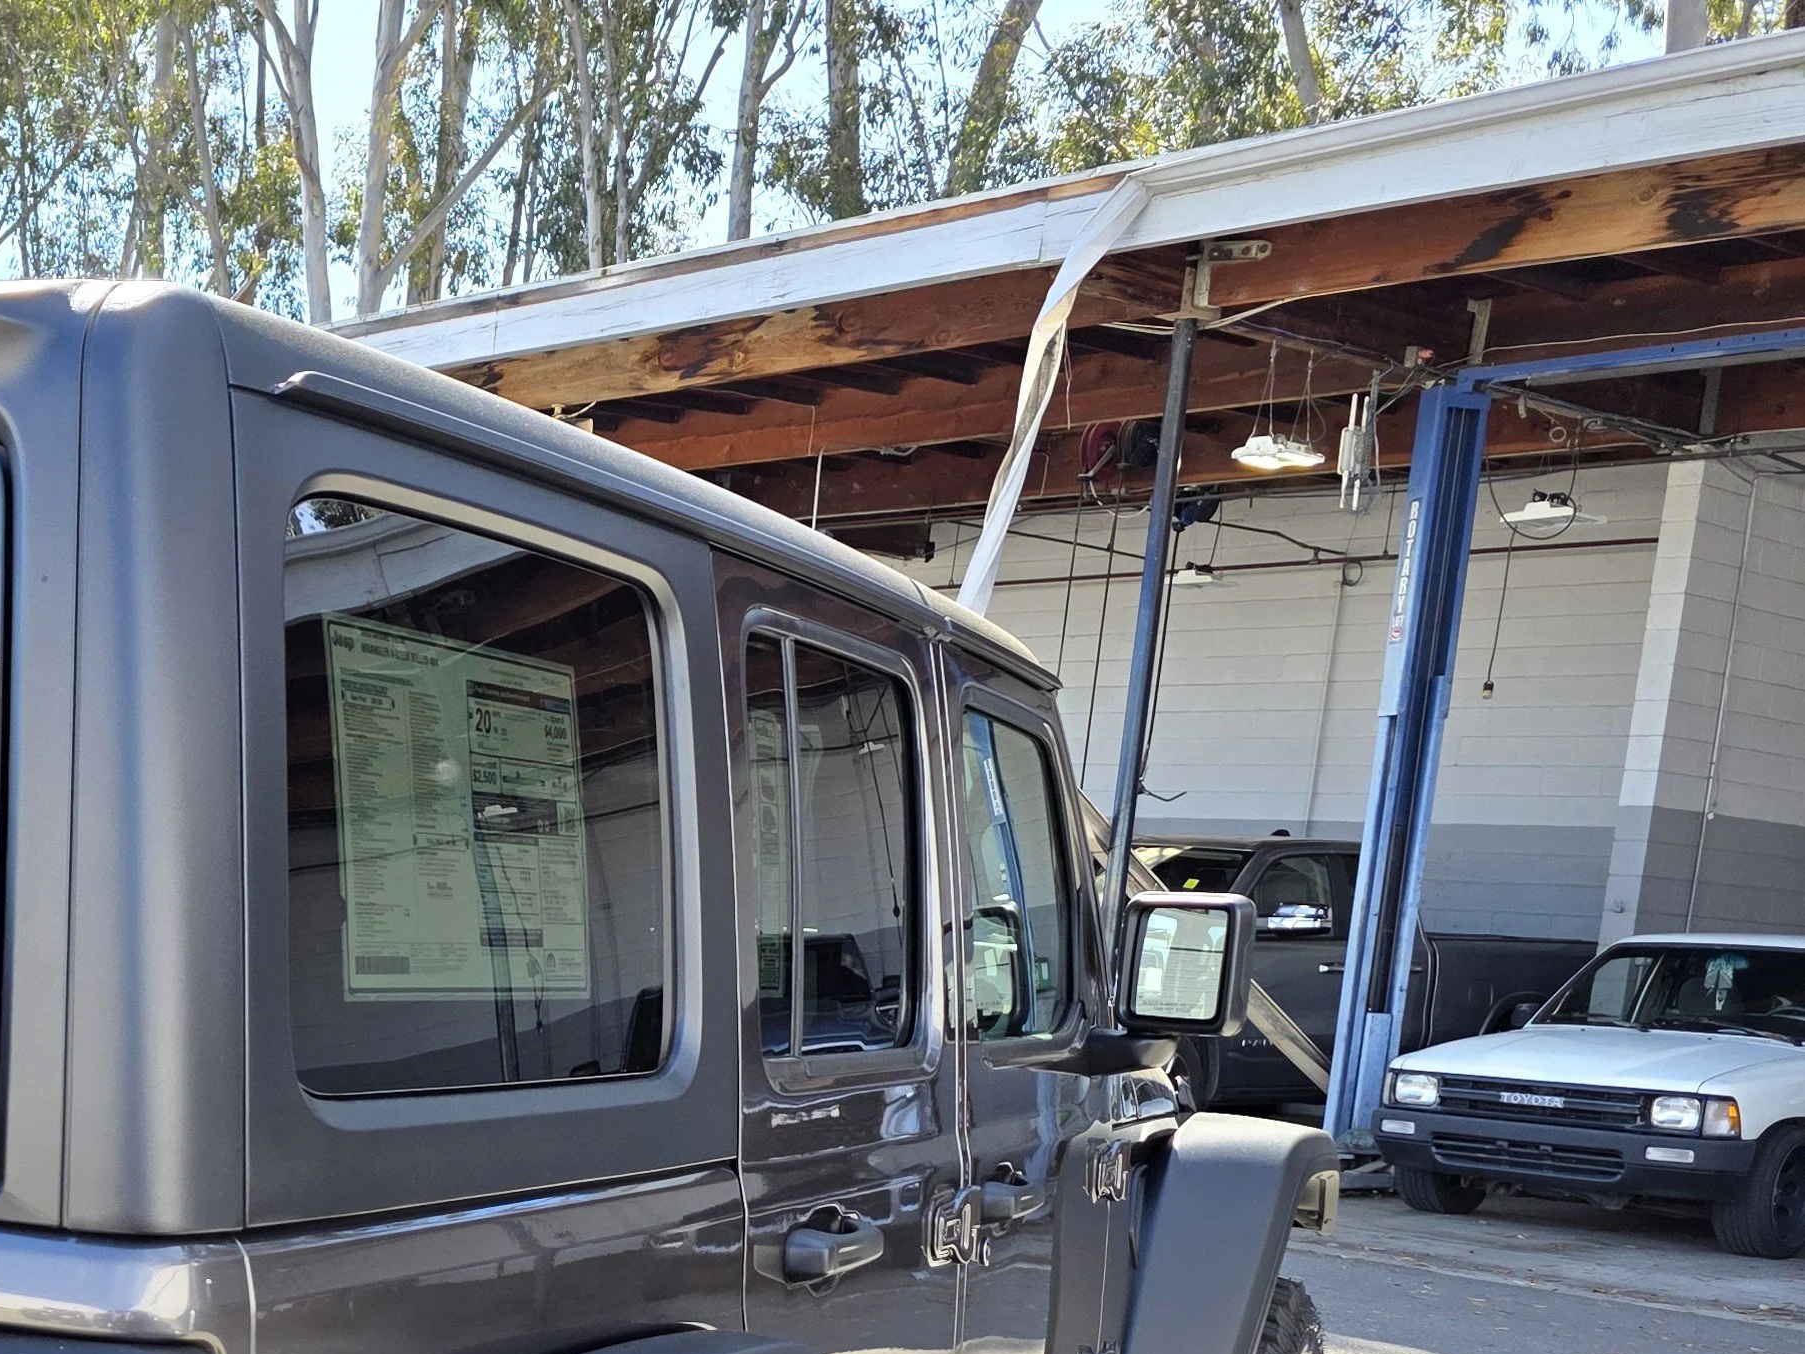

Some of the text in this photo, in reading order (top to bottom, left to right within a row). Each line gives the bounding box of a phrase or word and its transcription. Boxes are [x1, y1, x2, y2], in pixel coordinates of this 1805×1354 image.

[1398, 500, 1420, 614] ROTARY
[475, 707, 491, 734] 20
[1499, 1092, 1565, 1109] TOYOTA
